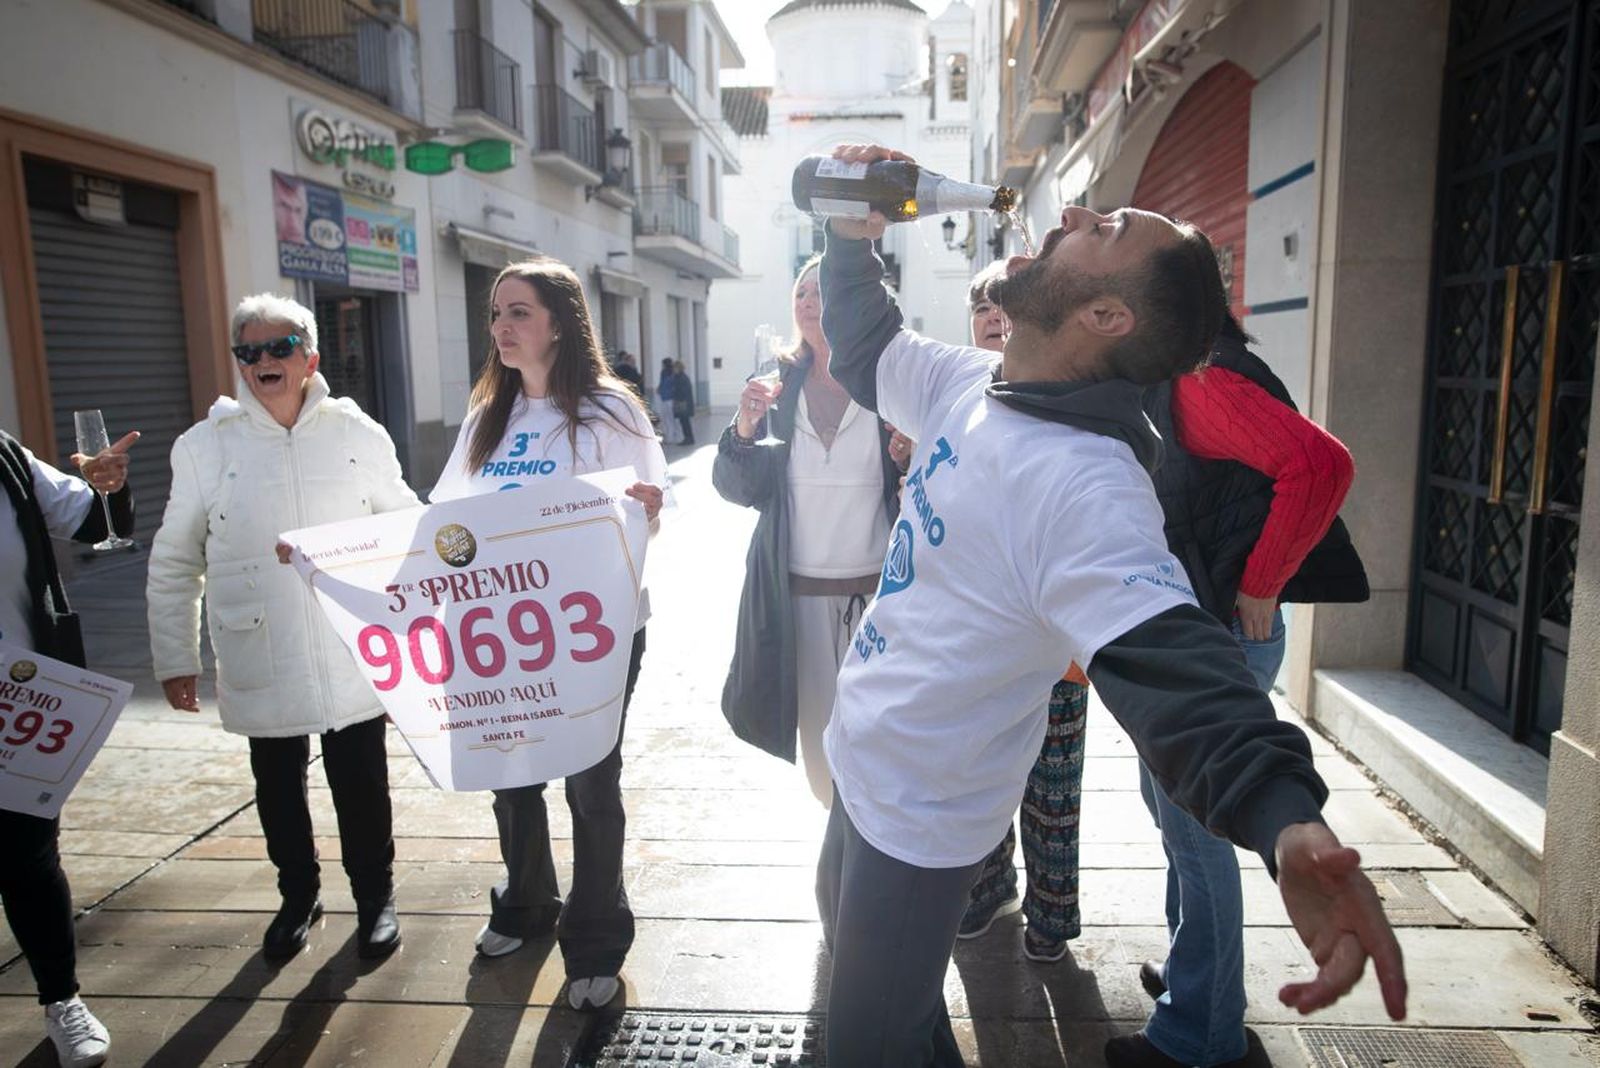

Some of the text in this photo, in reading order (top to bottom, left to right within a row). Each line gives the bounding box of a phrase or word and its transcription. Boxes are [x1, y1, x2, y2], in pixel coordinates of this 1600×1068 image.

[281, 255, 320, 272] GAMA
[319, 261, 346, 276] ALTA
[481, 459, 557, 477] PREMIO
[539, 496, 617, 517] 22 de Diciembre
[418, 559, 550, 607] PREMIO
[357, 590, 616, 692] 90693
[0, 679, 63, 713] REMIO
[427, 677, 558, 712] VENDIDO AQUÍ
[439, 720, 476, 731] ADMON.
[501, 713, 529, 725] REINA
[530, 707, 565, 720] ISABEL
[482, 730, 526, 743] SANTA FE
